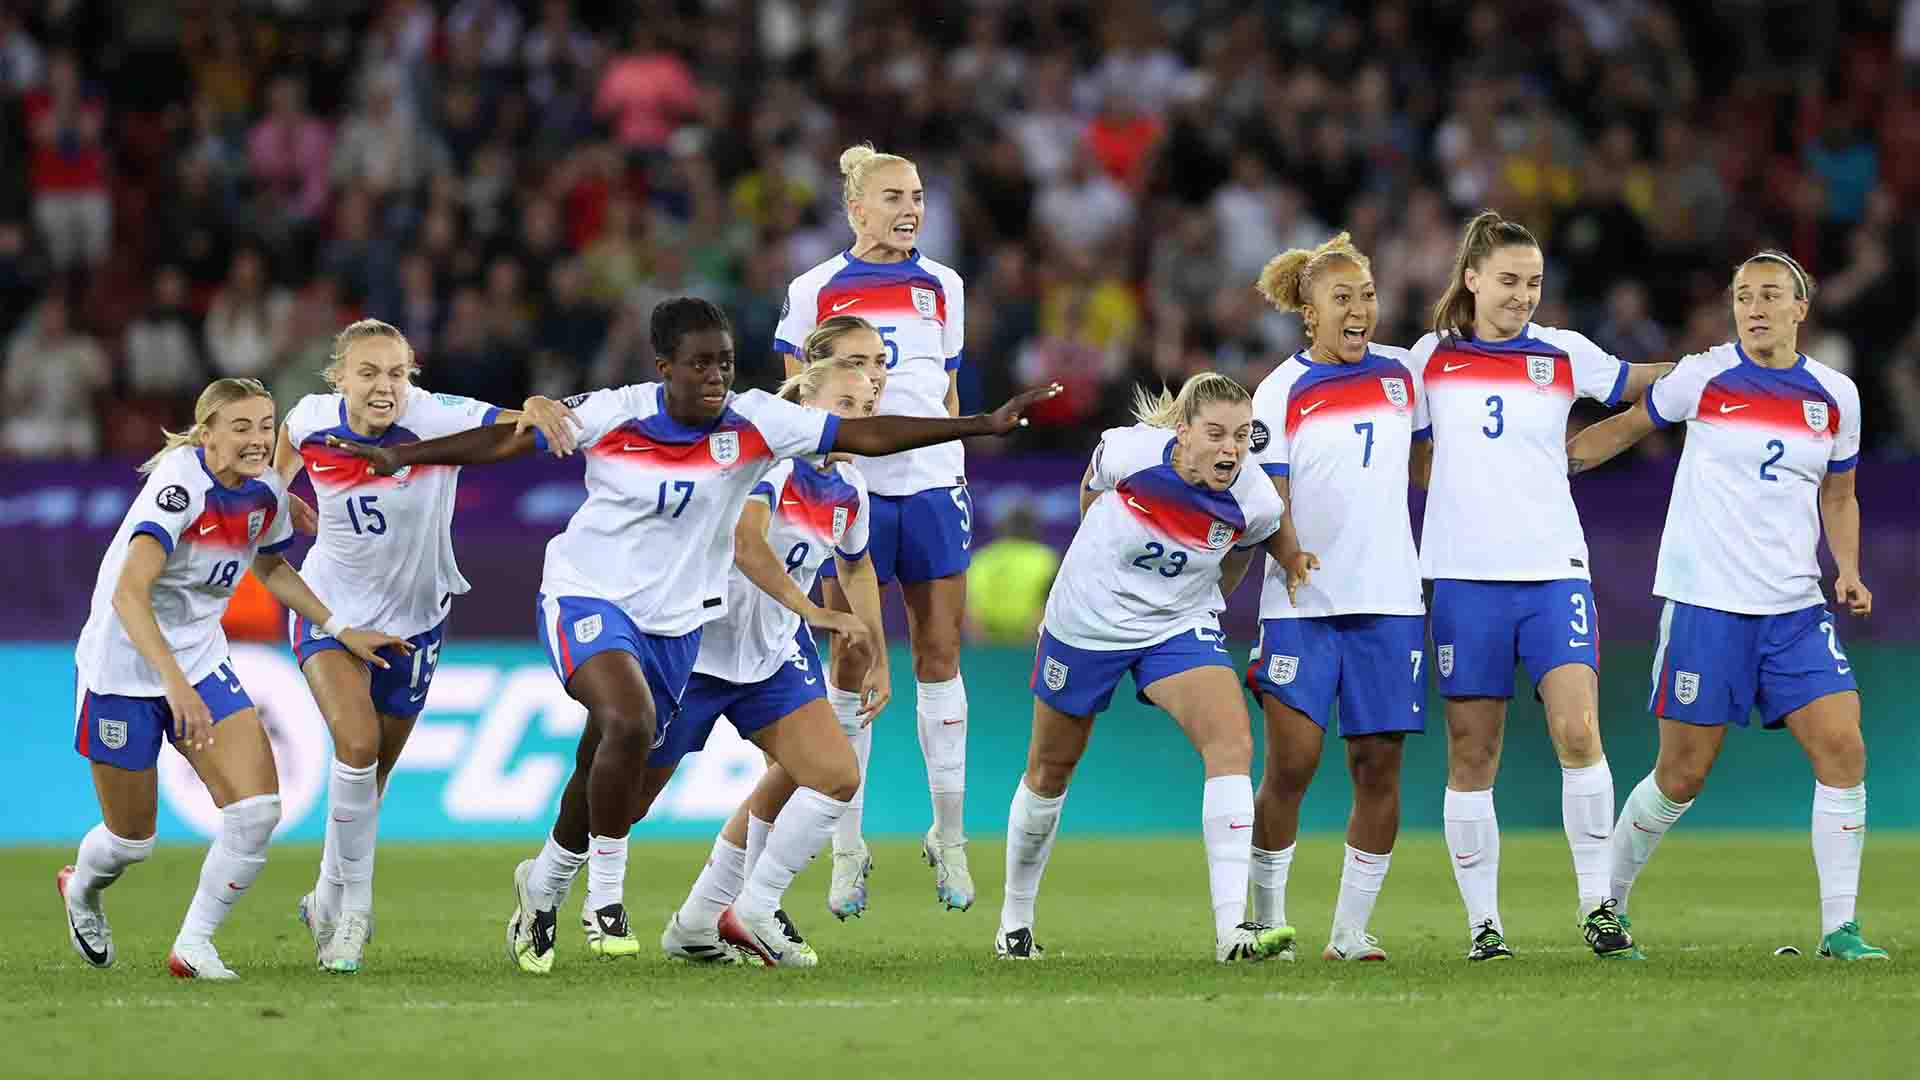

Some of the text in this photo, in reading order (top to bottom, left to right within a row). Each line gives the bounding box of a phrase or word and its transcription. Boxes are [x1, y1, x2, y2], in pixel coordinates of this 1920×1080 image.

[1482, 395, 1504, 439] 3
[1353, 422, 1374, 468] 7
[1760, 439, 1785, 481] 2
[346, 496, 387, 535] 15
[656, 480, 695, 518] 17
[951, 487, 971, 532] 5
[206, 560, 240, 588] 18
[785, 542, 810, 574] 9
[1133, 541, 1188, 578] 23
[1568, 592, 1590, 635] 3
[1819, 622, 1848, 661] 2
[409, 640, 440, 688] 15
[1410, 650, 1423, 683] 7
